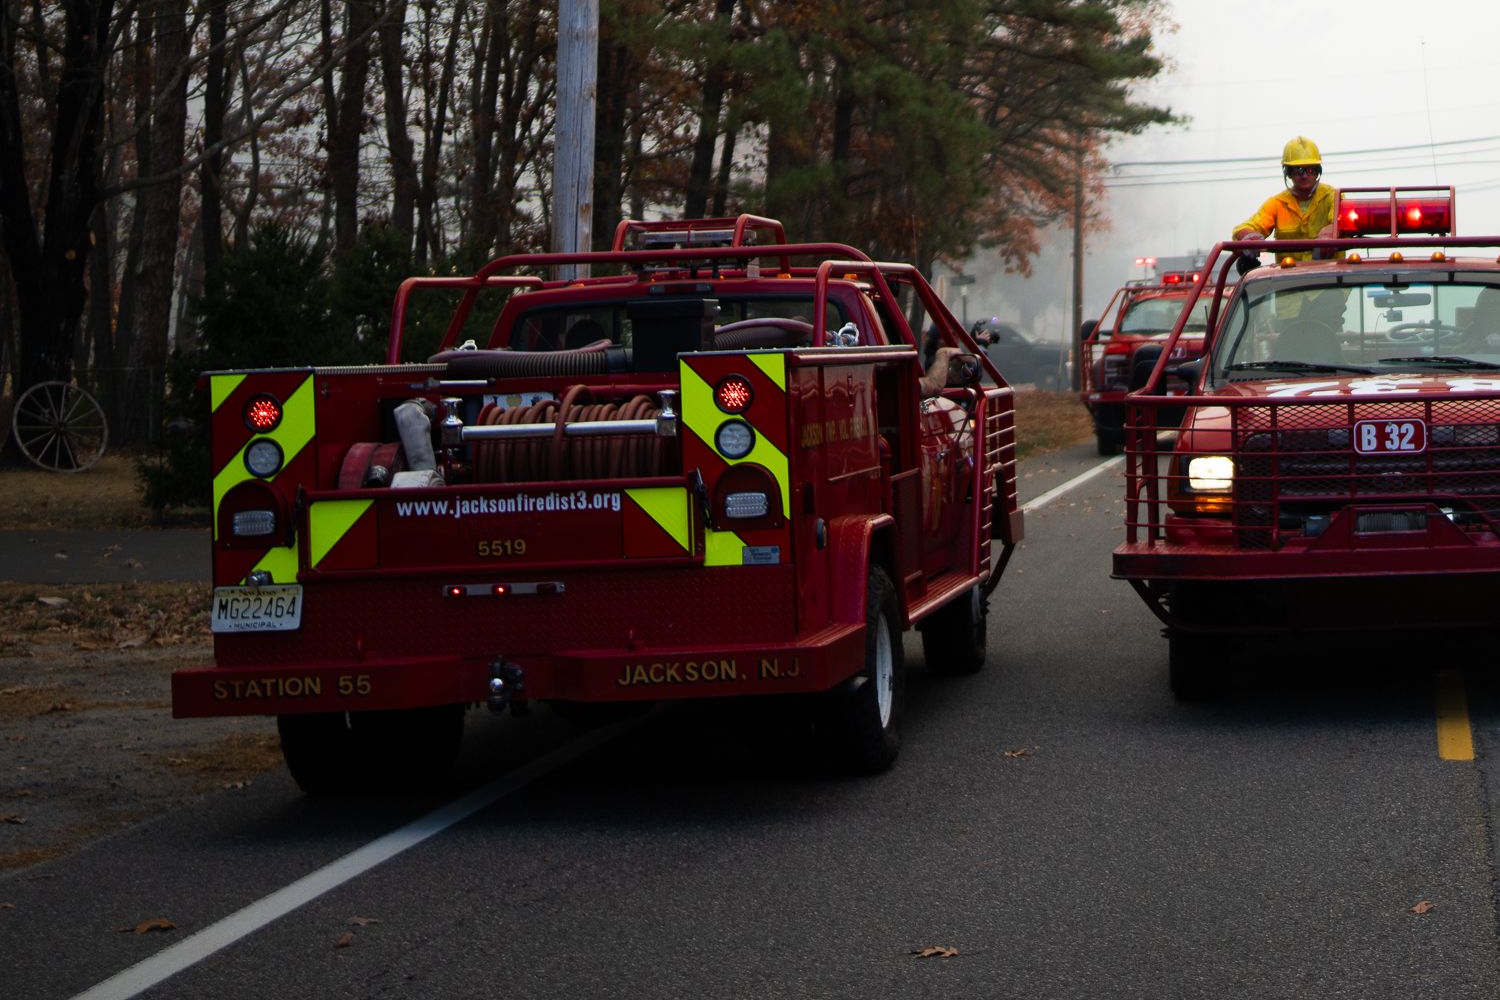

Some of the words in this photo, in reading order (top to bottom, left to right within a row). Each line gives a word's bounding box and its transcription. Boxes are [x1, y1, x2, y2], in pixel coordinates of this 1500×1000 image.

[1361, 424, 1377, 451] B
[1385, 423, 1415, 450] 32
[396, 490, 621, 518] www.jacksonfiredist3.org
[478, 539, 527, 557] 5519
[218, 597, 297, 620] MG22464
[233, 621, 278, 630] MUNICIPAL
[214, 677, 321, 699] STATION
[338, 675, 372, 695] 55
